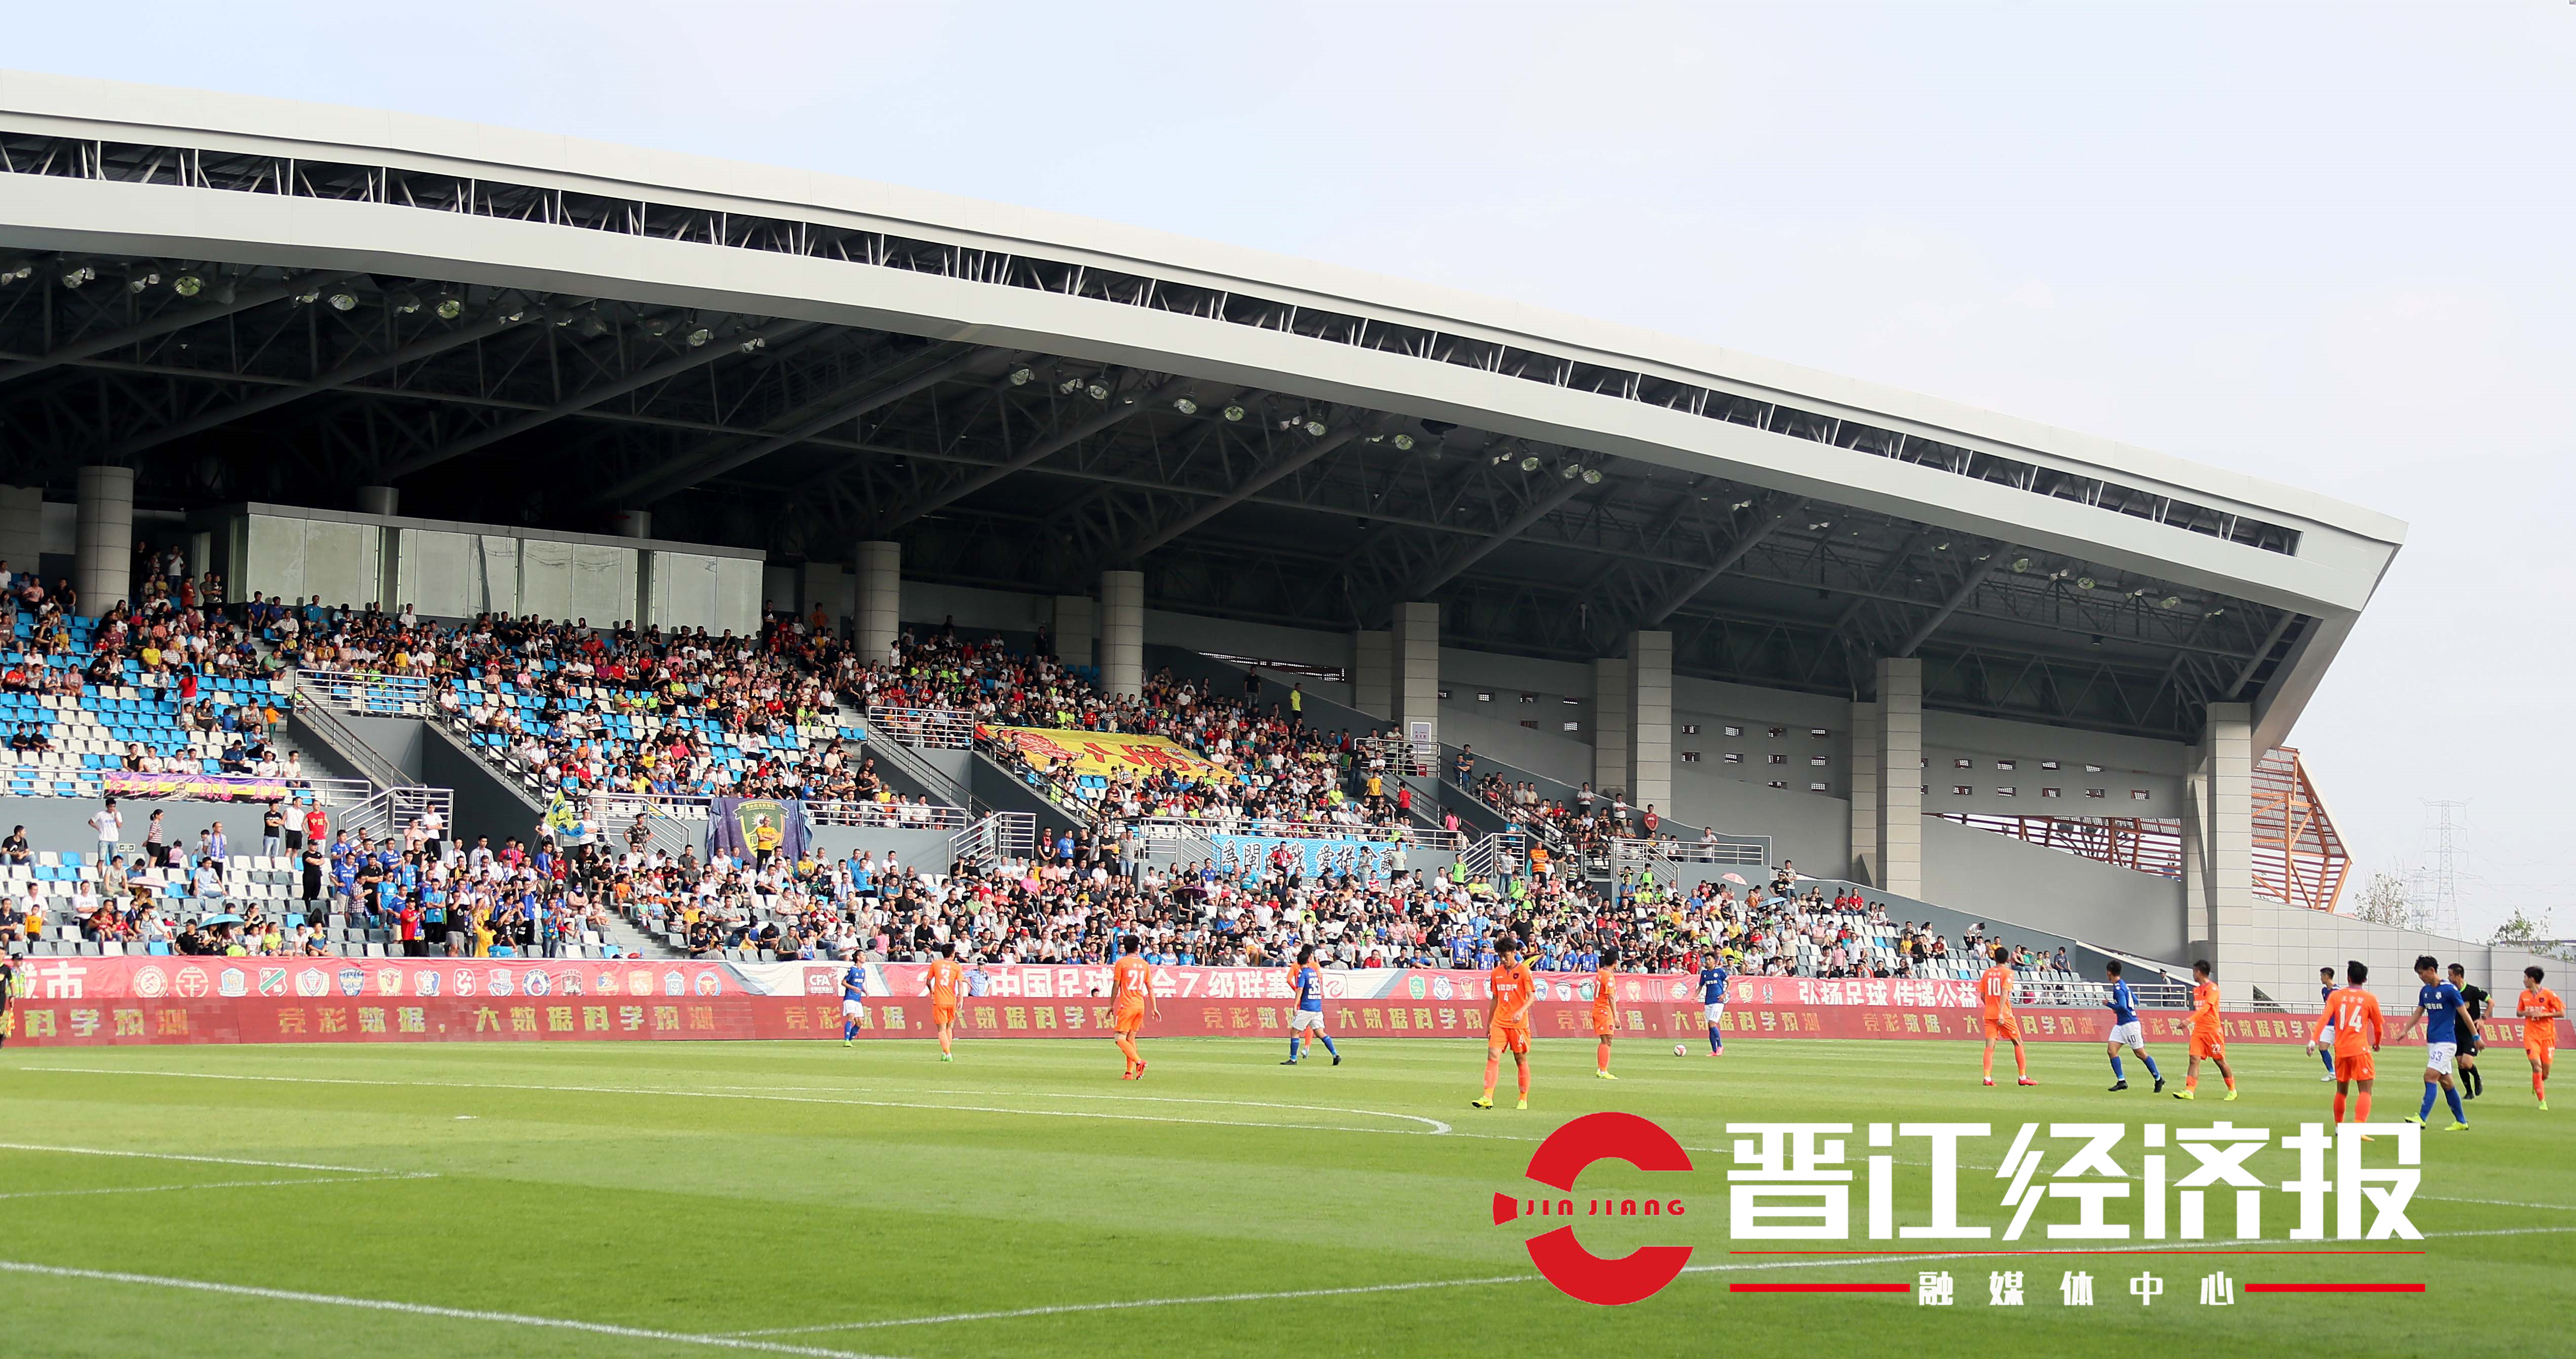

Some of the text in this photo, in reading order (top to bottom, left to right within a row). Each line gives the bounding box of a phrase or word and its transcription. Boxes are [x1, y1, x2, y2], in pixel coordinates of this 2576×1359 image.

[809, 974, 831, 986] CFA
[941, 968, 950, 986] 3
[1127, 970, 1145, 991] 21
[1309, 977, 1321, 995] 35
[1798, 980, 1977, 1008] 弘扬足球 传递公益
[1988, 977, 2001, 996] 10
[1503, 992, 1509, 1002] 4
[2339, 1003, 2362, 1033] 14
[2211, 1043, 2222, 1054] 22
[2431, 1050, 2443, 1062] 33
